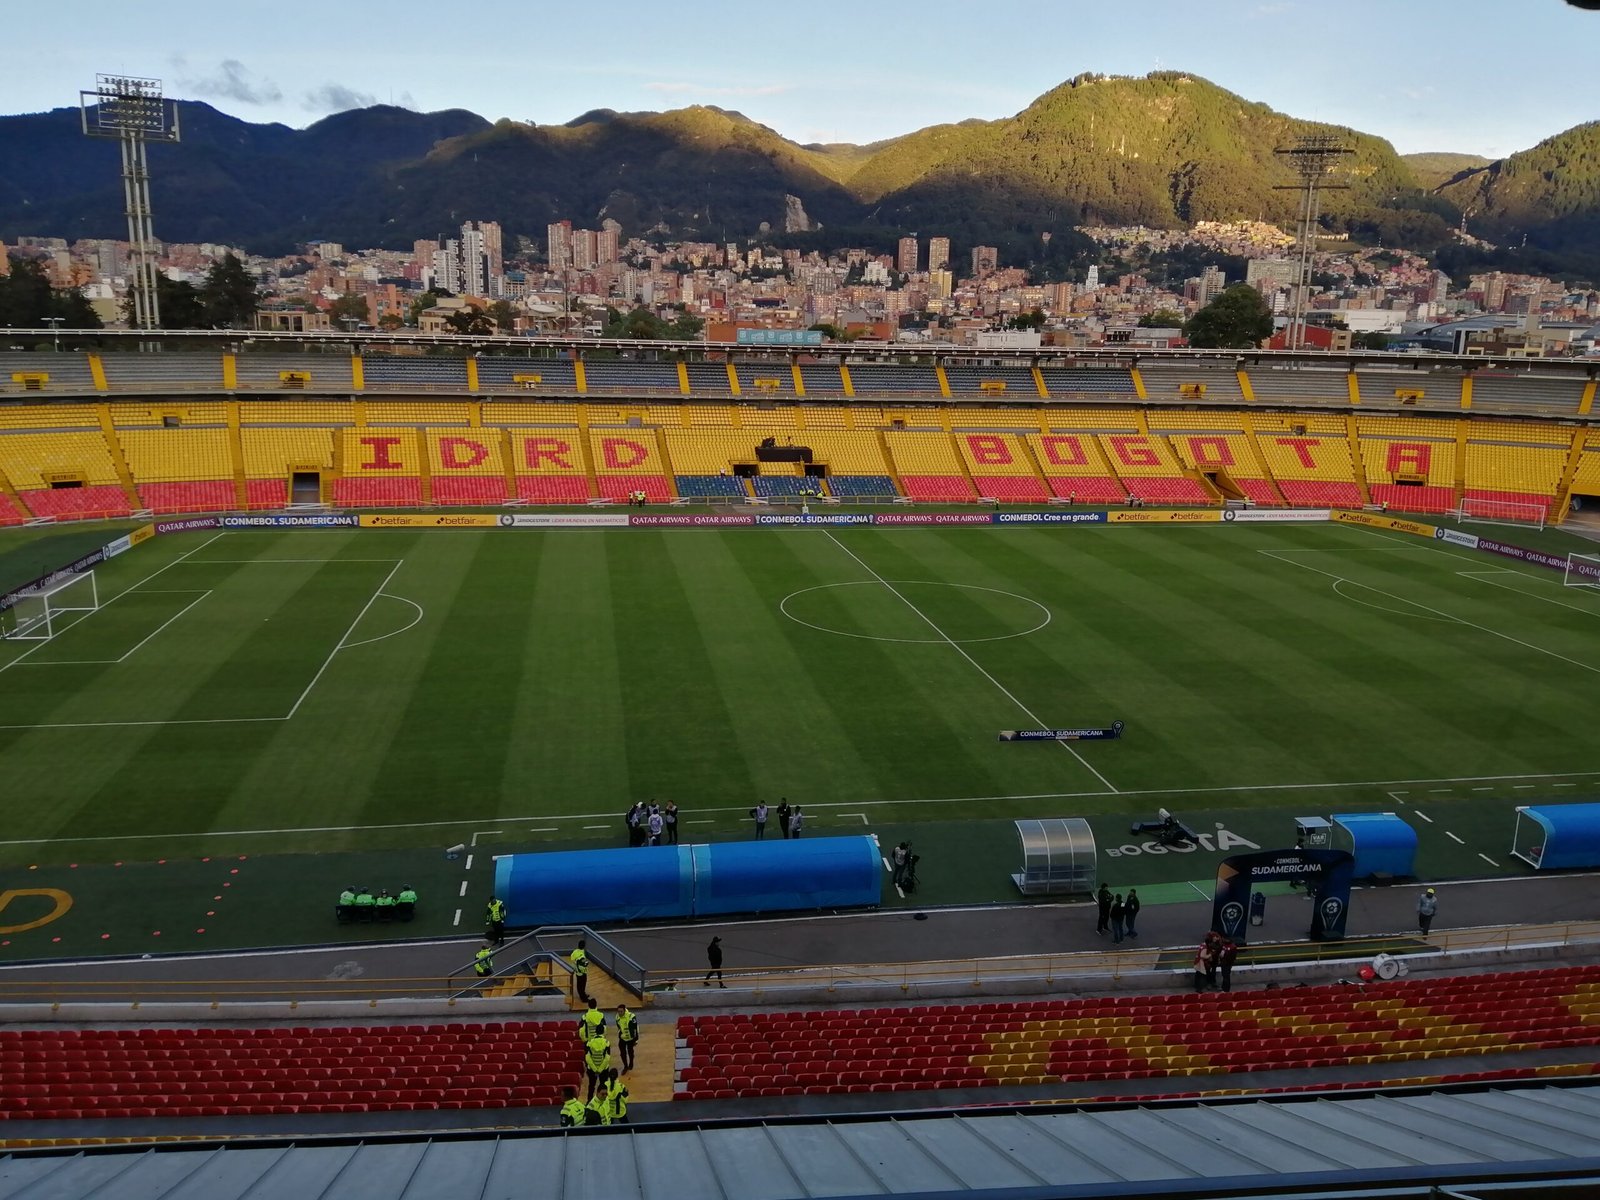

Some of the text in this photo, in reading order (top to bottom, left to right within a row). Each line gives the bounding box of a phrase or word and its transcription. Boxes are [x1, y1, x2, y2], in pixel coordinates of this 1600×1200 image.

[225, 516, 351, 526] CONMEBOL SUDAMERICANA
[658, 516, 690, 524] AIRWAYS
[694, 516, 719, 524] QATAR
[806, 515, 869, 523] SUDAMERICANA
[877, 515, 902, 523] QATAR
[960, 514, 990, 522] AIRWAYS
[1000, 513, 1043, 521] CONMEBOL
[1044, 513, 1061, 521] Cree
[1072, 513, 1099, 522] grande
[158, 518, 215, 533] QATAR AIRWAYS
[1479, 540, 1524, 557] QATAR AIRWAYS
[1526, 552, 1547, 564] QATAR
[1251, 863, 1322, 875] SUDAMERICANA
